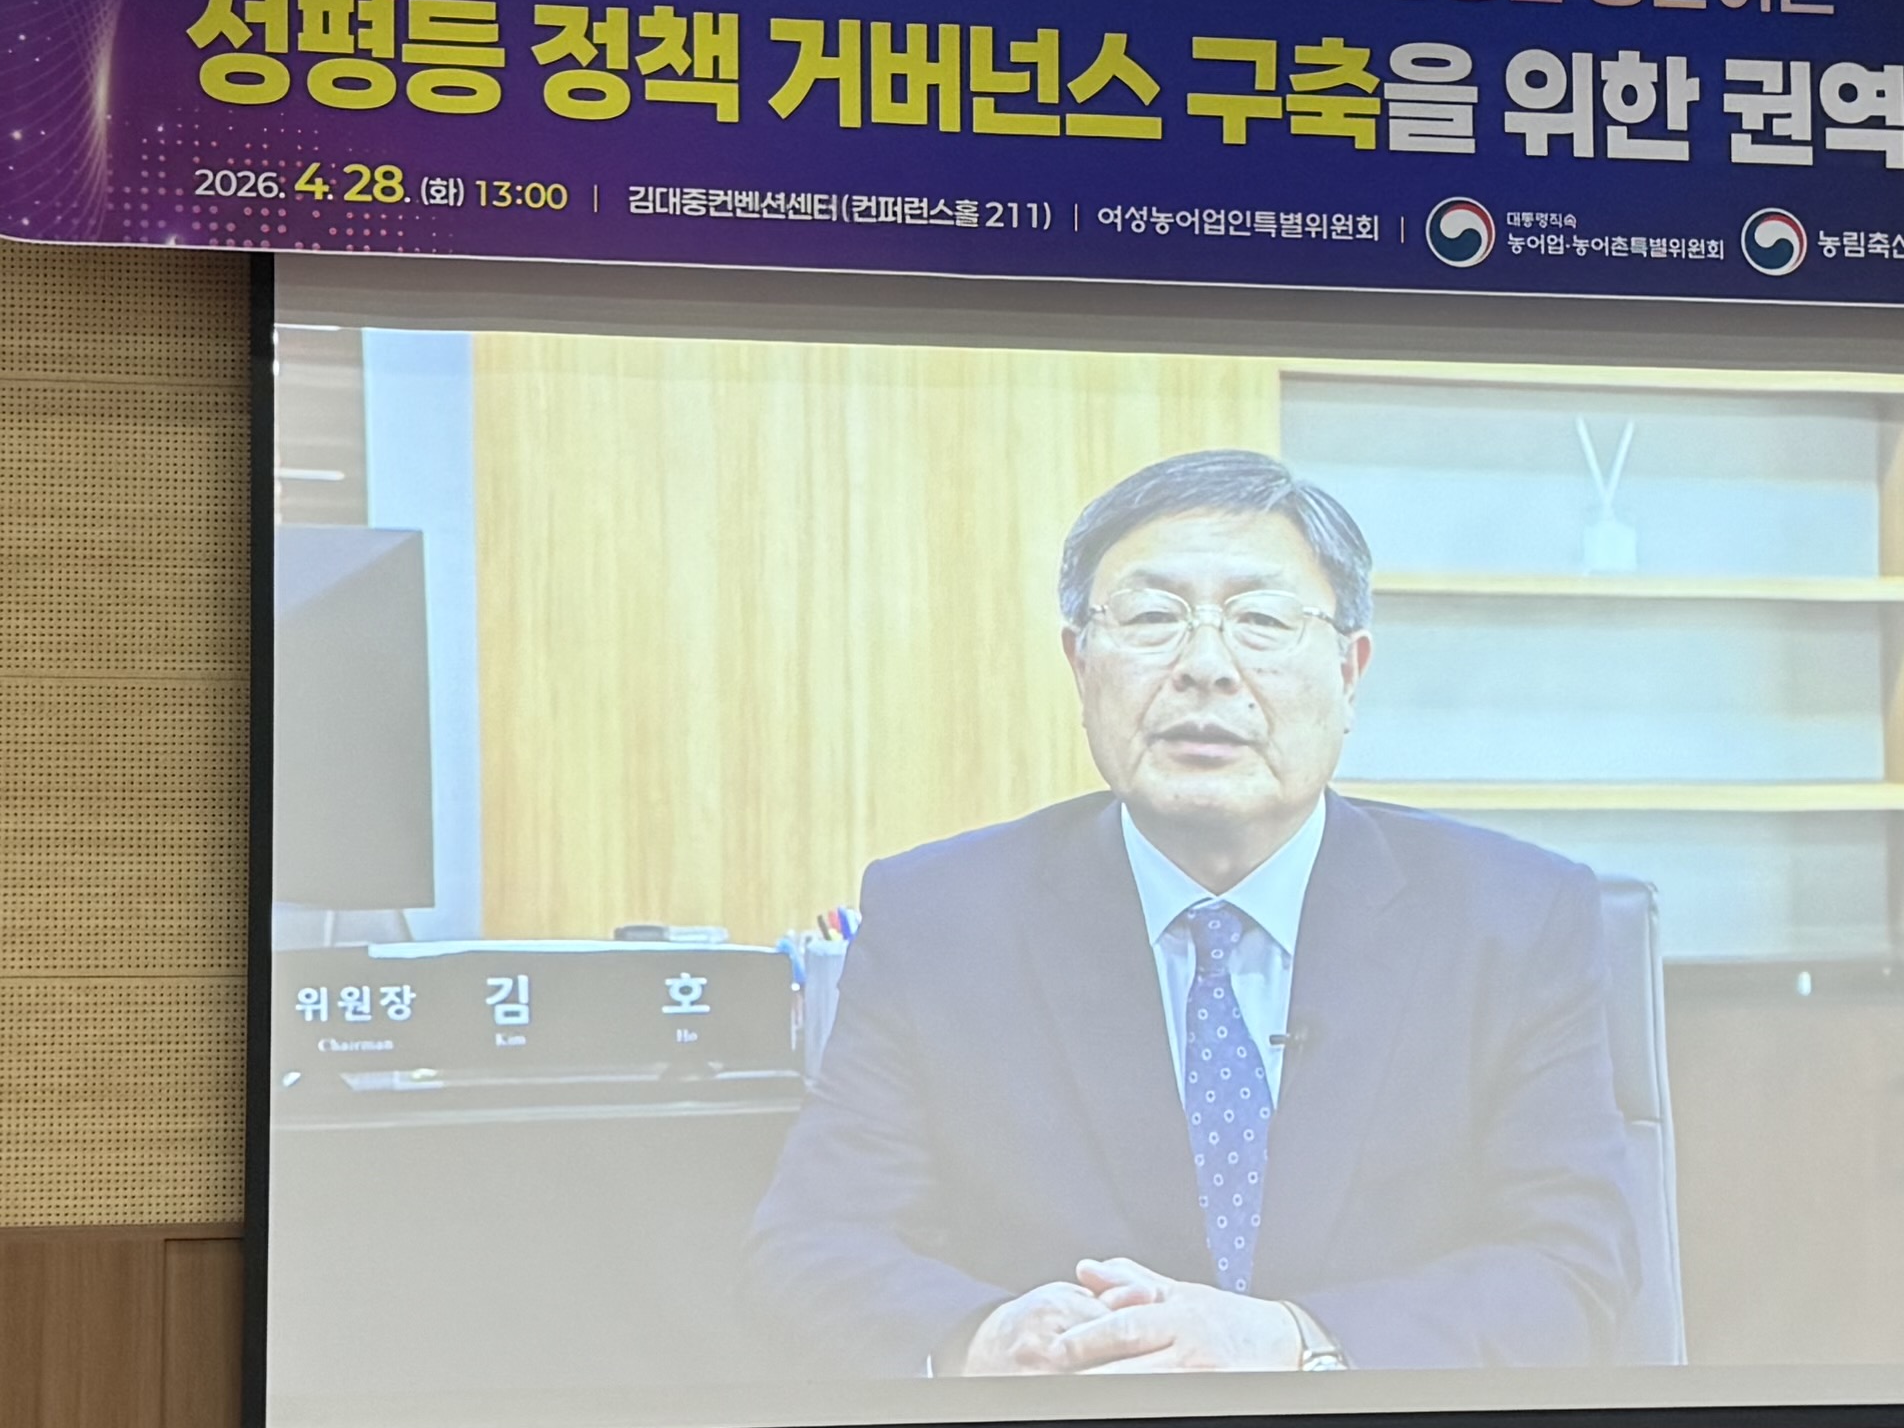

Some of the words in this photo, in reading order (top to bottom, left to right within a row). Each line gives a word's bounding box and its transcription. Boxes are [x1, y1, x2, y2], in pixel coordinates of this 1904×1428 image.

[531, 4, 739, 123] 정책
[768, 18, 1163, 140] 거버넌스
[1186, 36, 1479, 154] 구축을
[1504, 48, 1700, 161] 위한
[194, 168, 287, 199] 2026.
[294, 162, 334, 201] 4.
[342, 164, 412, 203] 28.
[419, 177, 466, 208] (화)
[474, 180, 569, 210] 13:00
[1097, 204, 1380, 242] 여성농어업인특별위원회
[295, 984, 417, 1022] 위원장
[485, 974, 530, 1025] 김
[661, 972, 711, 1014] 호
[317, 1037, 394, 1053] Chairman
